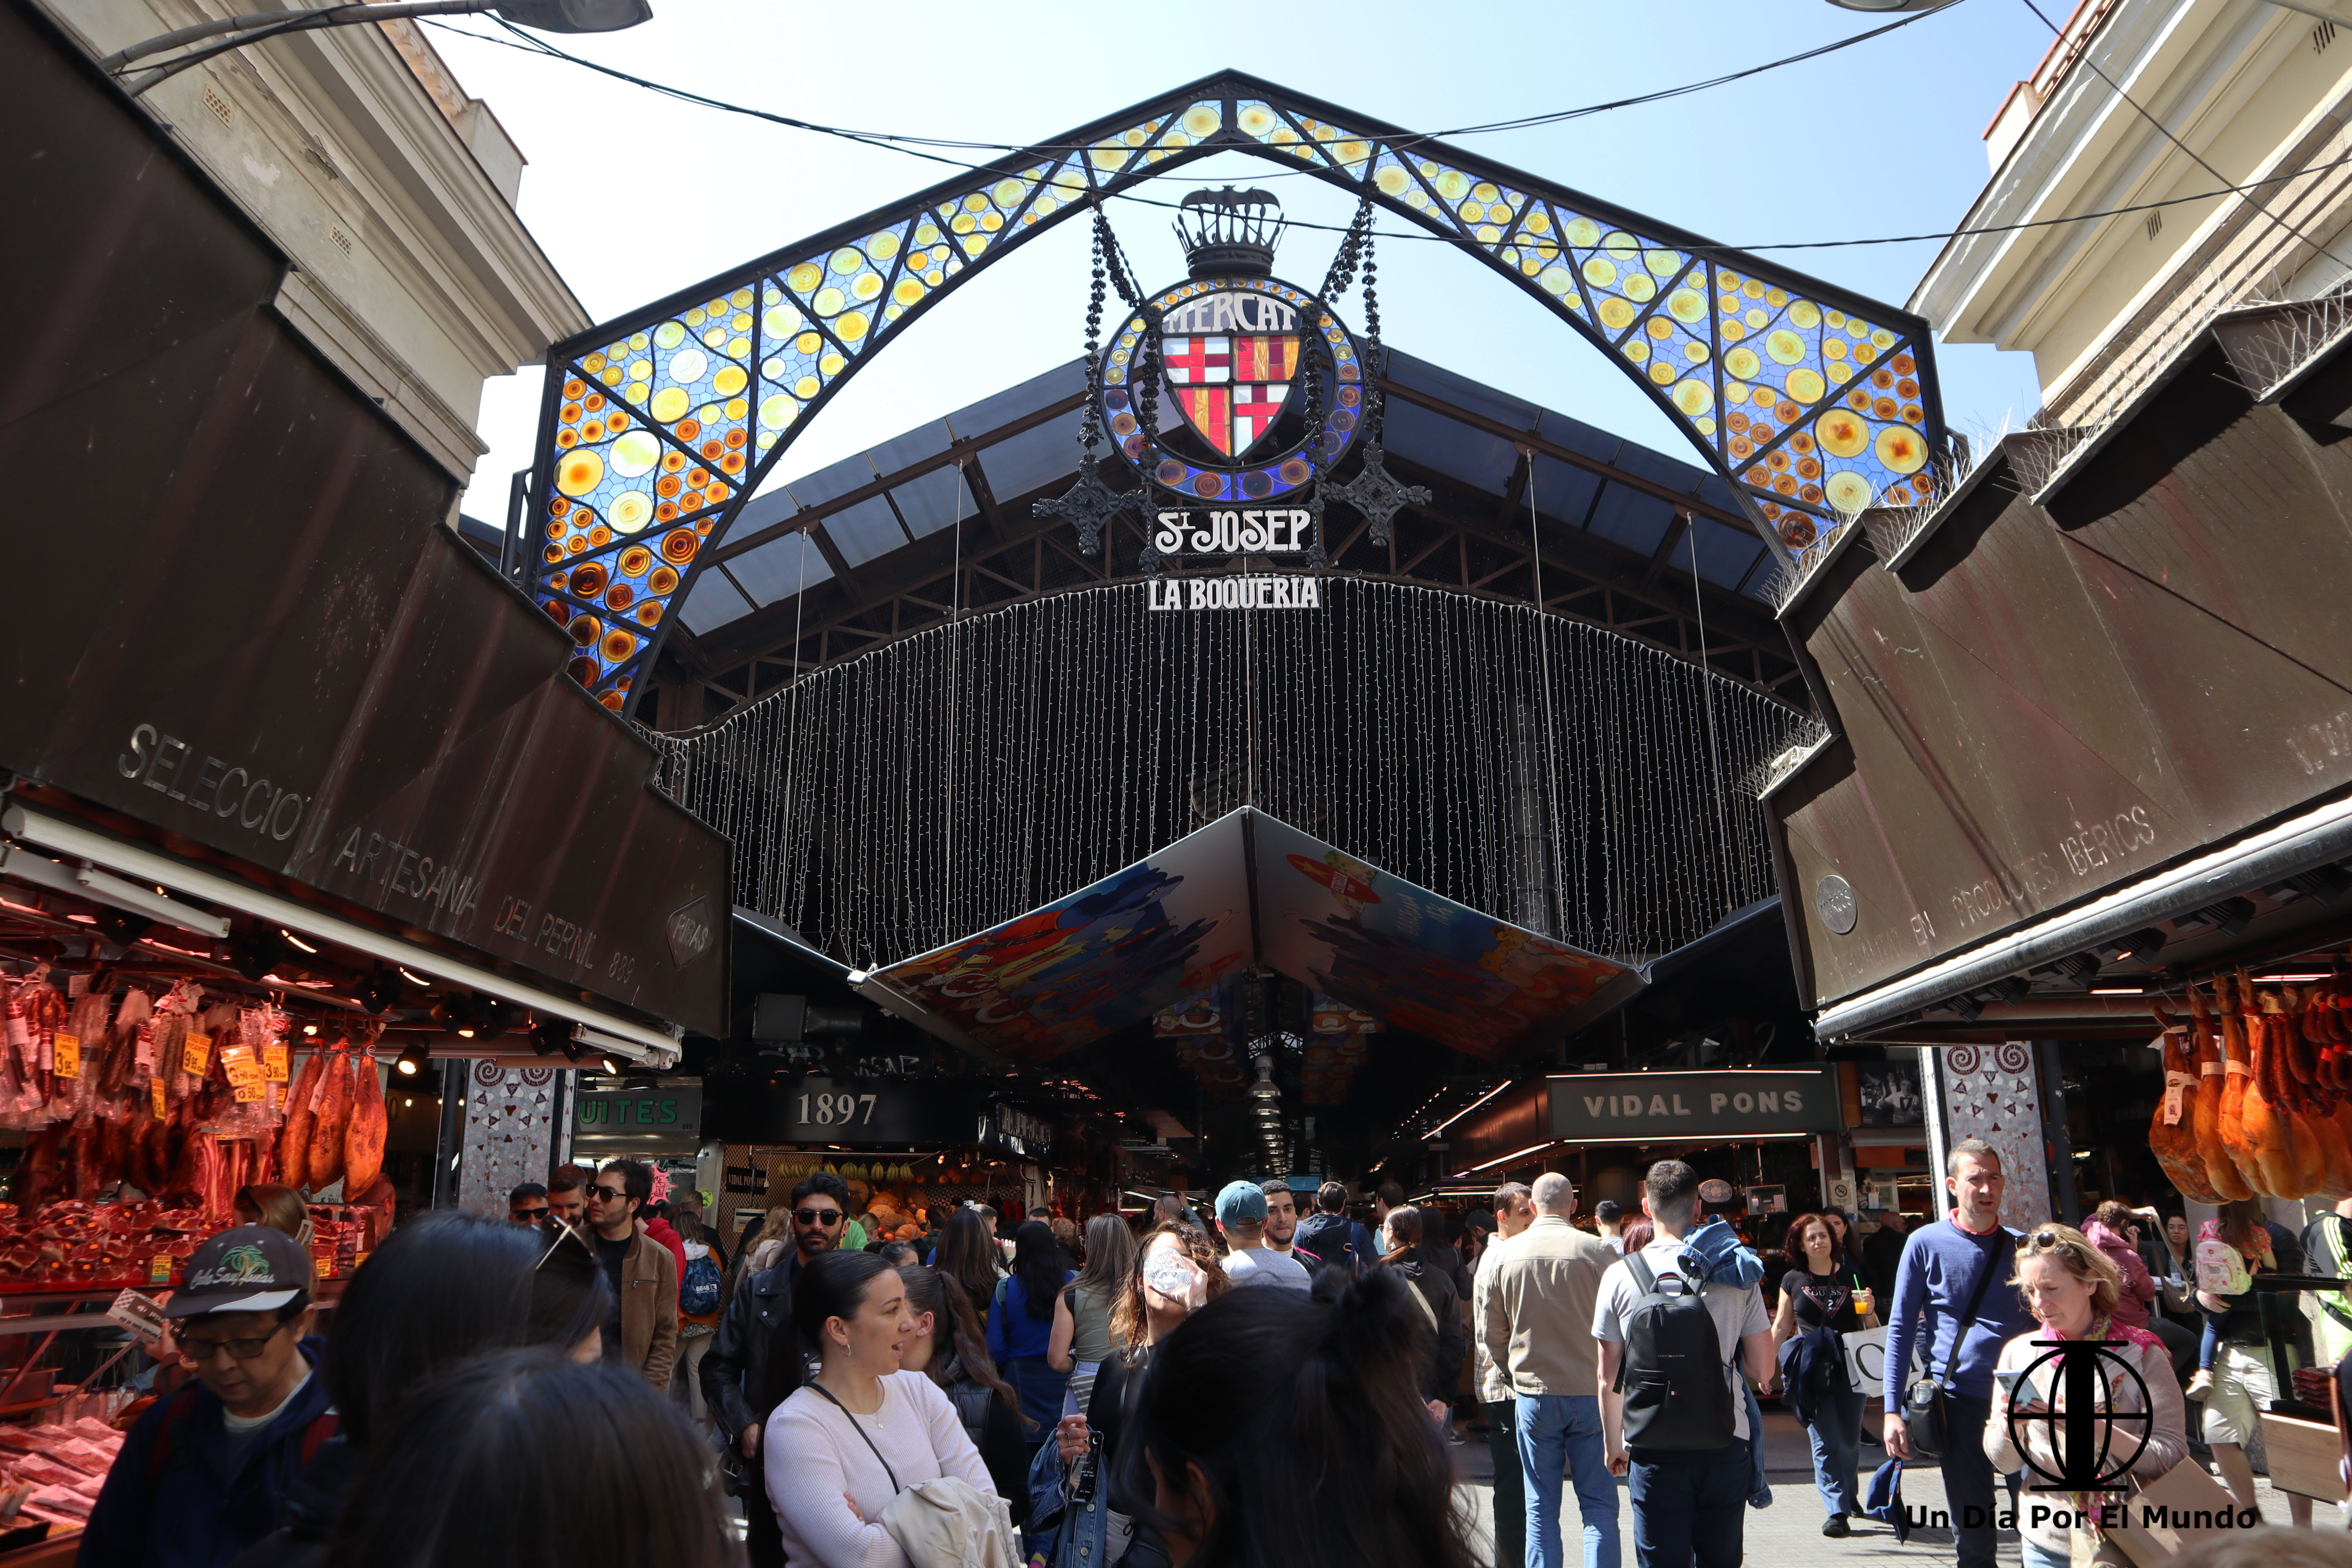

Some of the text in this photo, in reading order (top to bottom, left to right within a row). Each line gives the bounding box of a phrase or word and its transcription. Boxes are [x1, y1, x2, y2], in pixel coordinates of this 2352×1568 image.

[1163, 293, 1296, 332] MERCAT
[1191, 510, 1310, 552] JOSEP
[1149, 577, 1319, 610] LA BOQUERIA
[493, 895, 532, 942] DEL
[534, 913, 597, 969] PERNIL
[608, 951, 635, 984] 889
[673, 914, 709, 953] RIBAS
[797, 1093, 877, 1125] 1897
[1583, 1091, 1804, 1118] VIDAL PONS
[728, 1174, 742, 1185] VIDAL
